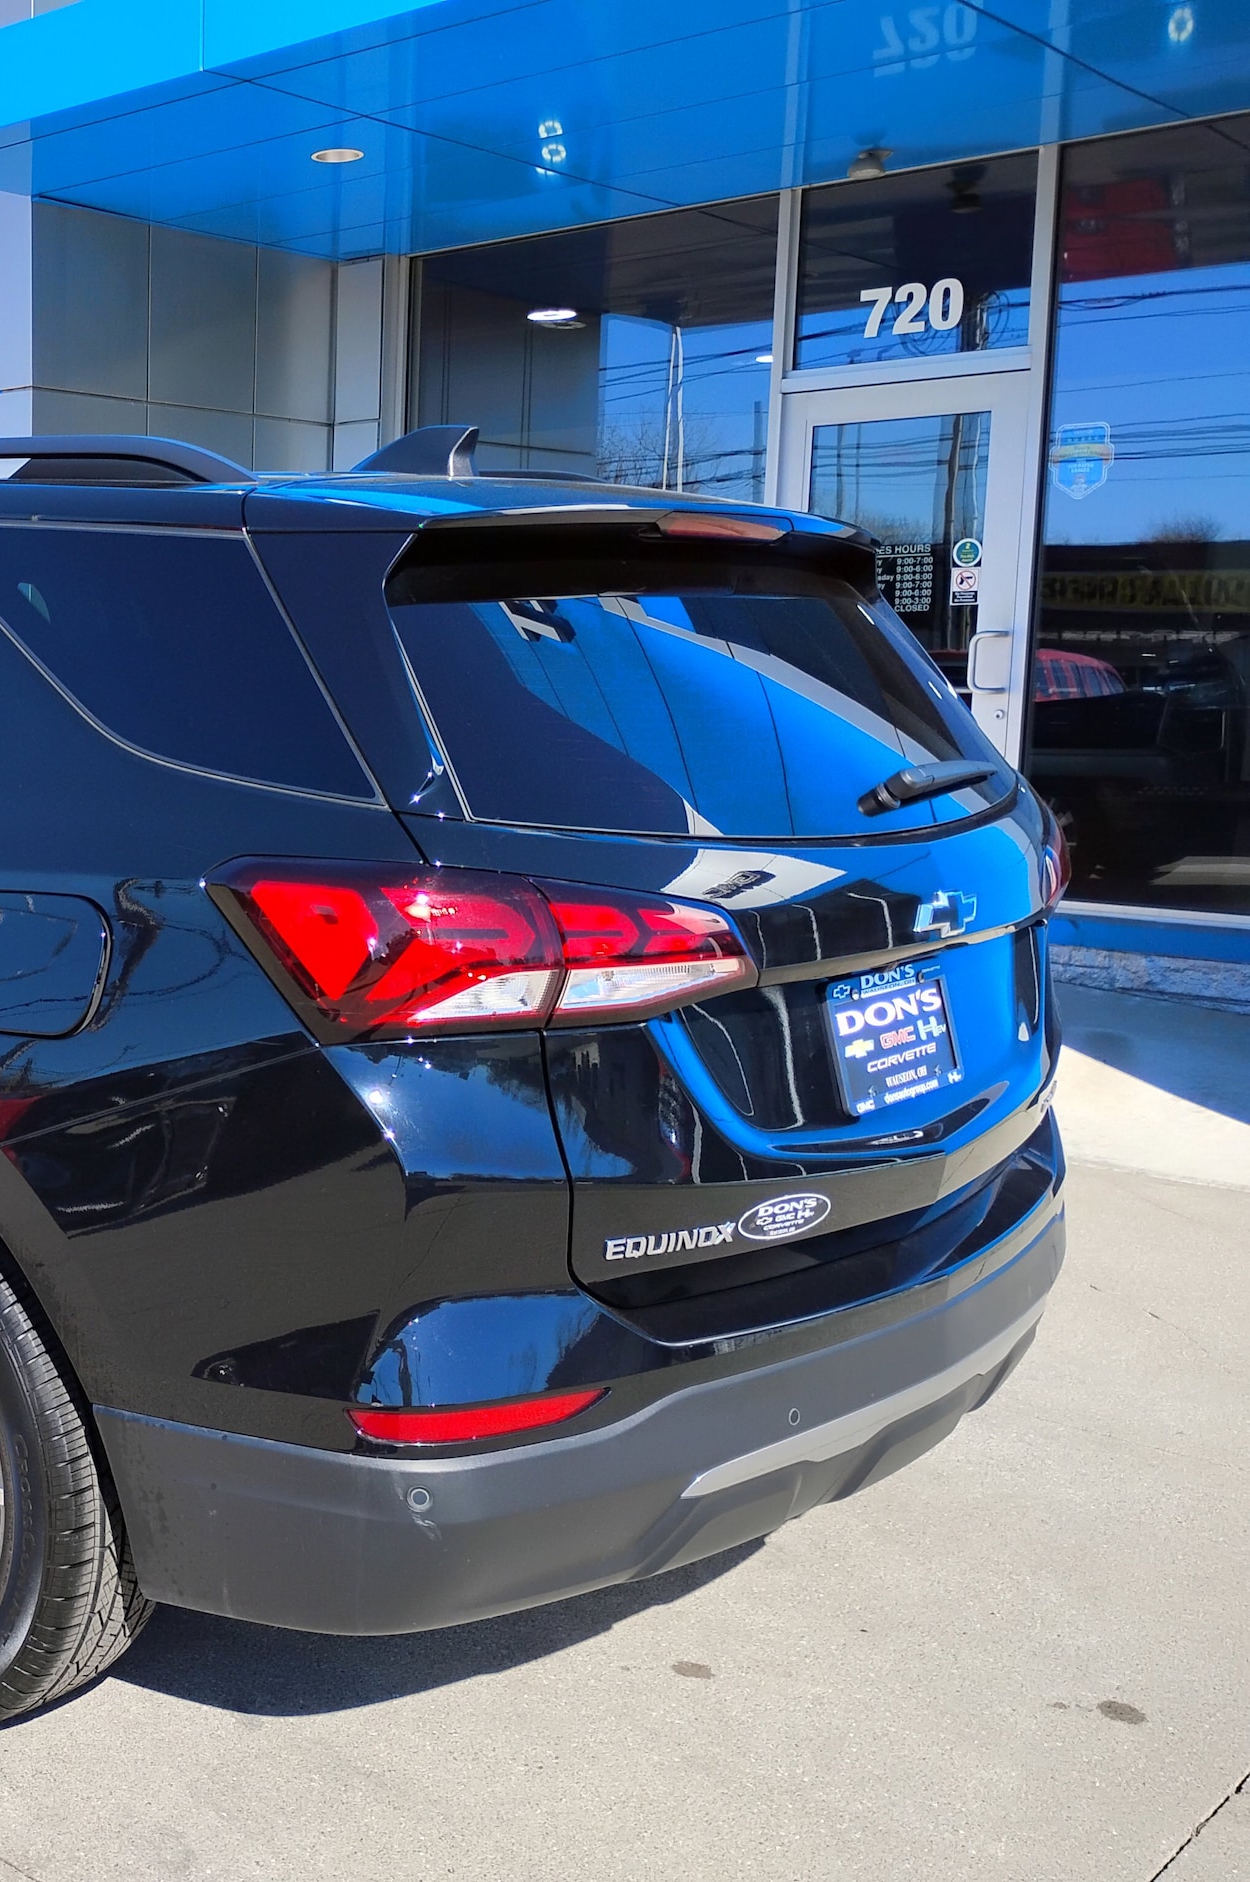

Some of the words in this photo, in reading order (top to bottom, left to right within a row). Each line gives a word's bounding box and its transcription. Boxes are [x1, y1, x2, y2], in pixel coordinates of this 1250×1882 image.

[859, 277, 964, 338] 720
[894, 543, 932, 554] HOURS
[896, 556, 934, 565] 9:00-7:00
[896, 565, 933, 574] 9:00-6:00
[895, 573, 933, 581] 9:00-6:00
[895, 581, 933, 590] 9:00-7:00
[894, 589, 932, 598] 9:00-6:00
[894, 597, 932, 605] 9:00-3:00
[894, 604, 930, 613] CLOSED
[860, 963, 915, 990] DON'S
[834, 987, 943, 1037] DON'S
[879, 1025, 917, 1050] GMC
[867, 1042, 937, 1073] CORVETTE
[856, 1099, 876, 1114] GMC
[757, 1197, 818, 1217] DON'S
[605, 1221, 737, 1261] EQUINOX
